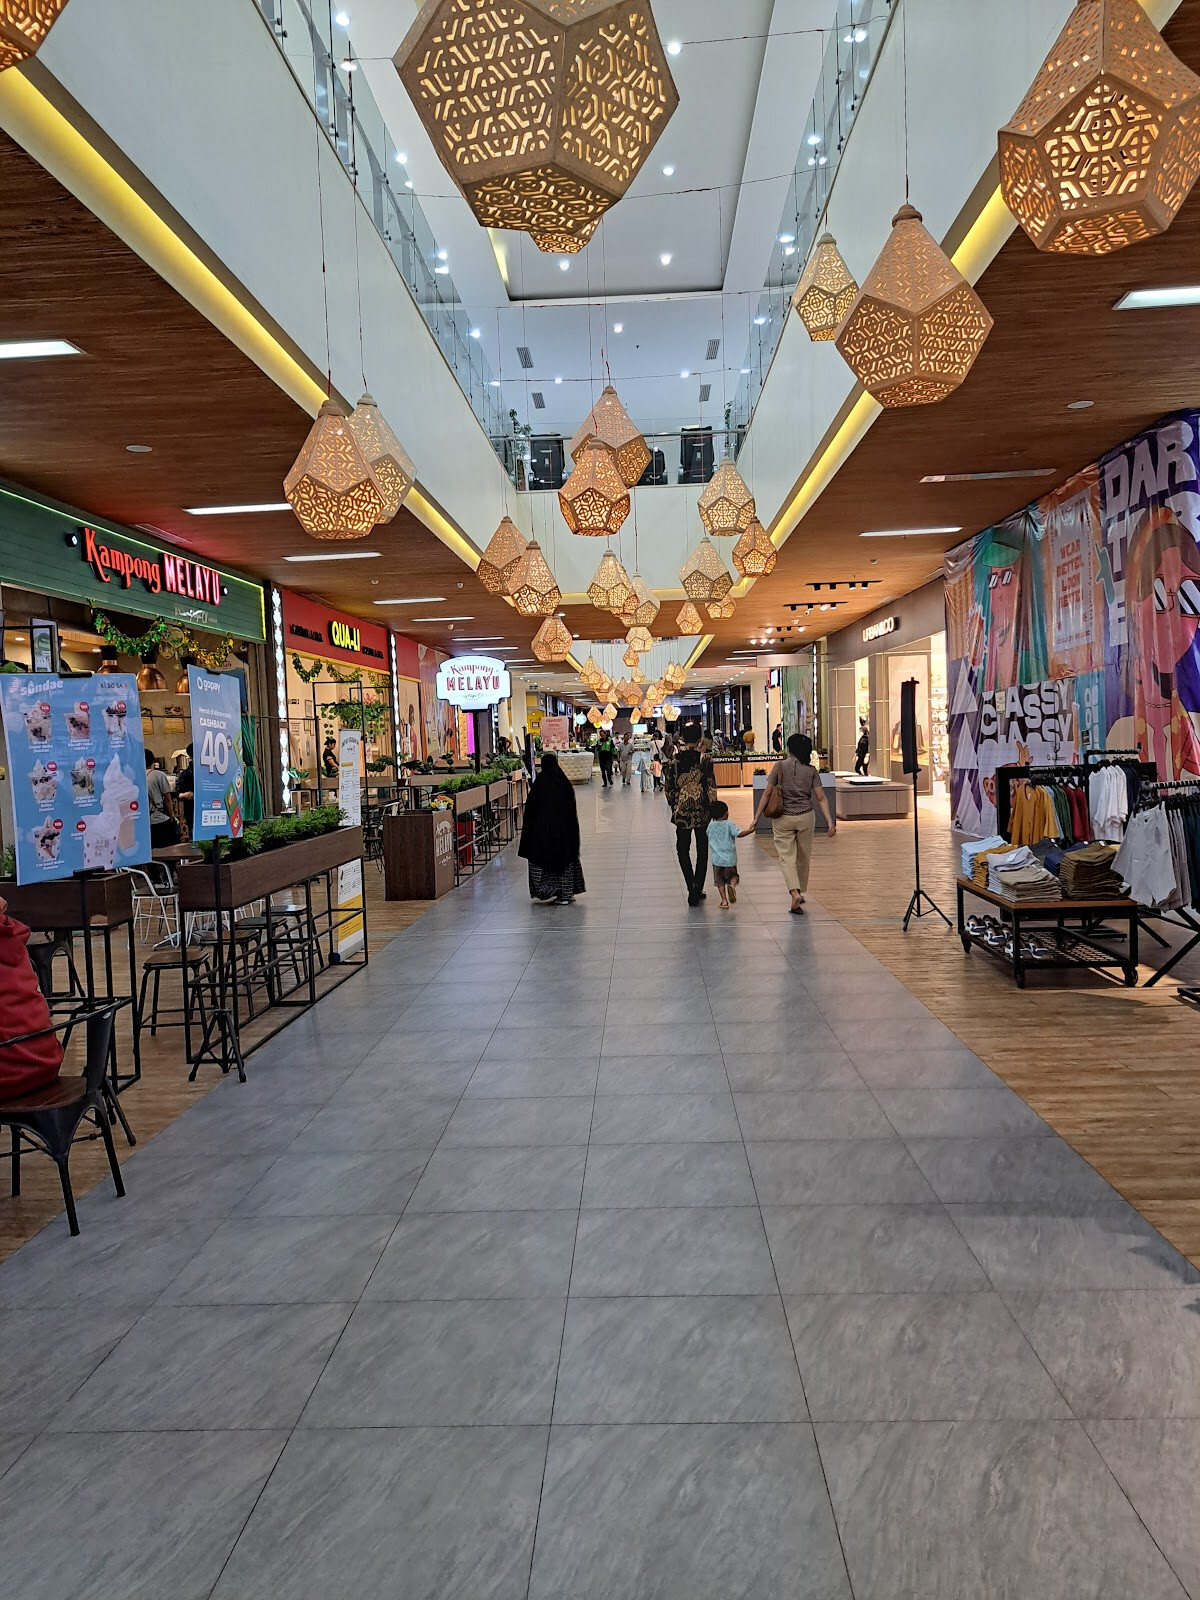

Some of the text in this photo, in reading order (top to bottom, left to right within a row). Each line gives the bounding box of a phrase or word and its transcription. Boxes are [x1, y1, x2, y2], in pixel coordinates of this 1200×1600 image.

[1104, 420, 1200, 520] DAR
[84, 527, 221, 606] Kampong MELAYU
[331, 620, 361, 652] QUA-LI
[450, 664, 494, 676] Kampong
[203, 680, 221, 693] gopay
[446, 675, 500, 691] MELAYU
[199, 717, 227, 730] CASHBACK
